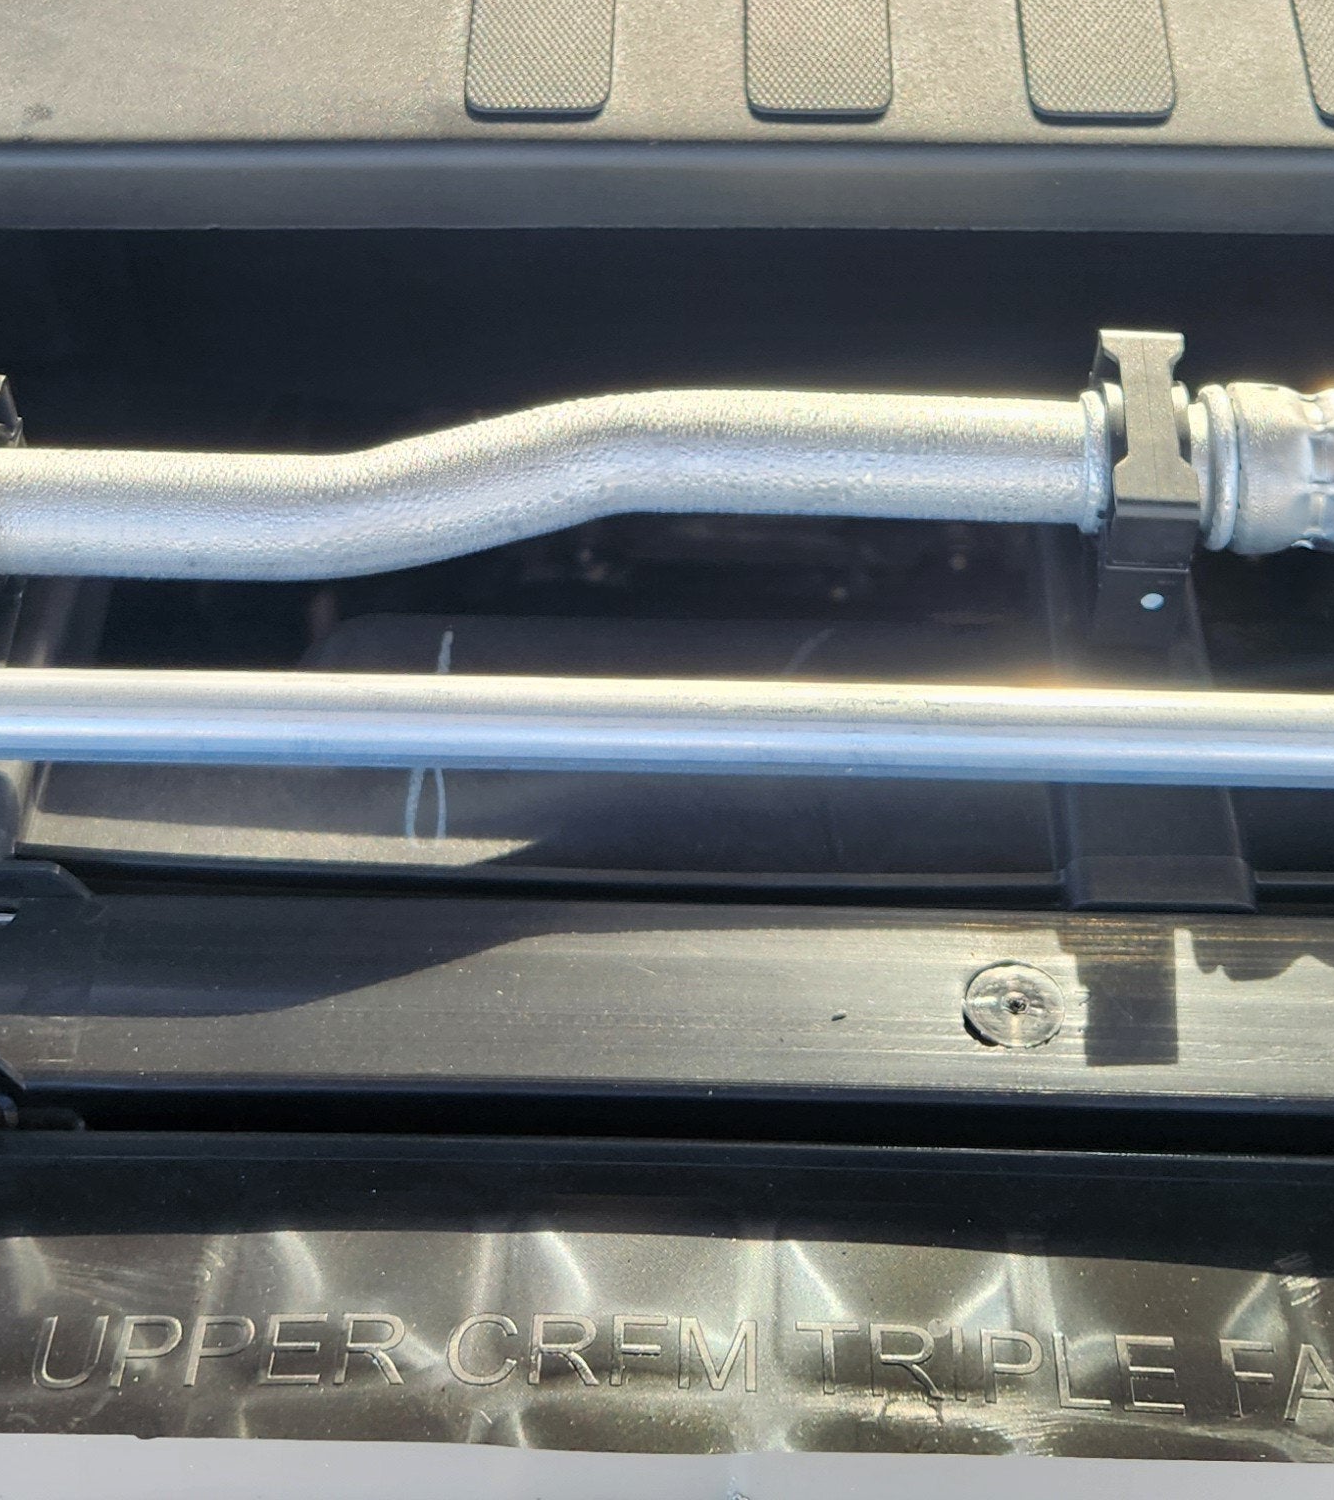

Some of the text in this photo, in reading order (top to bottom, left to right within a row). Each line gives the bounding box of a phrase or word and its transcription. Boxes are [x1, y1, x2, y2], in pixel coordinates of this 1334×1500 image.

[31, 1312, 407, 1390] UPPER
[446, 1312, 758, 1393] CRFM
[795, 1320, 1186, 1417] TRIPLE
